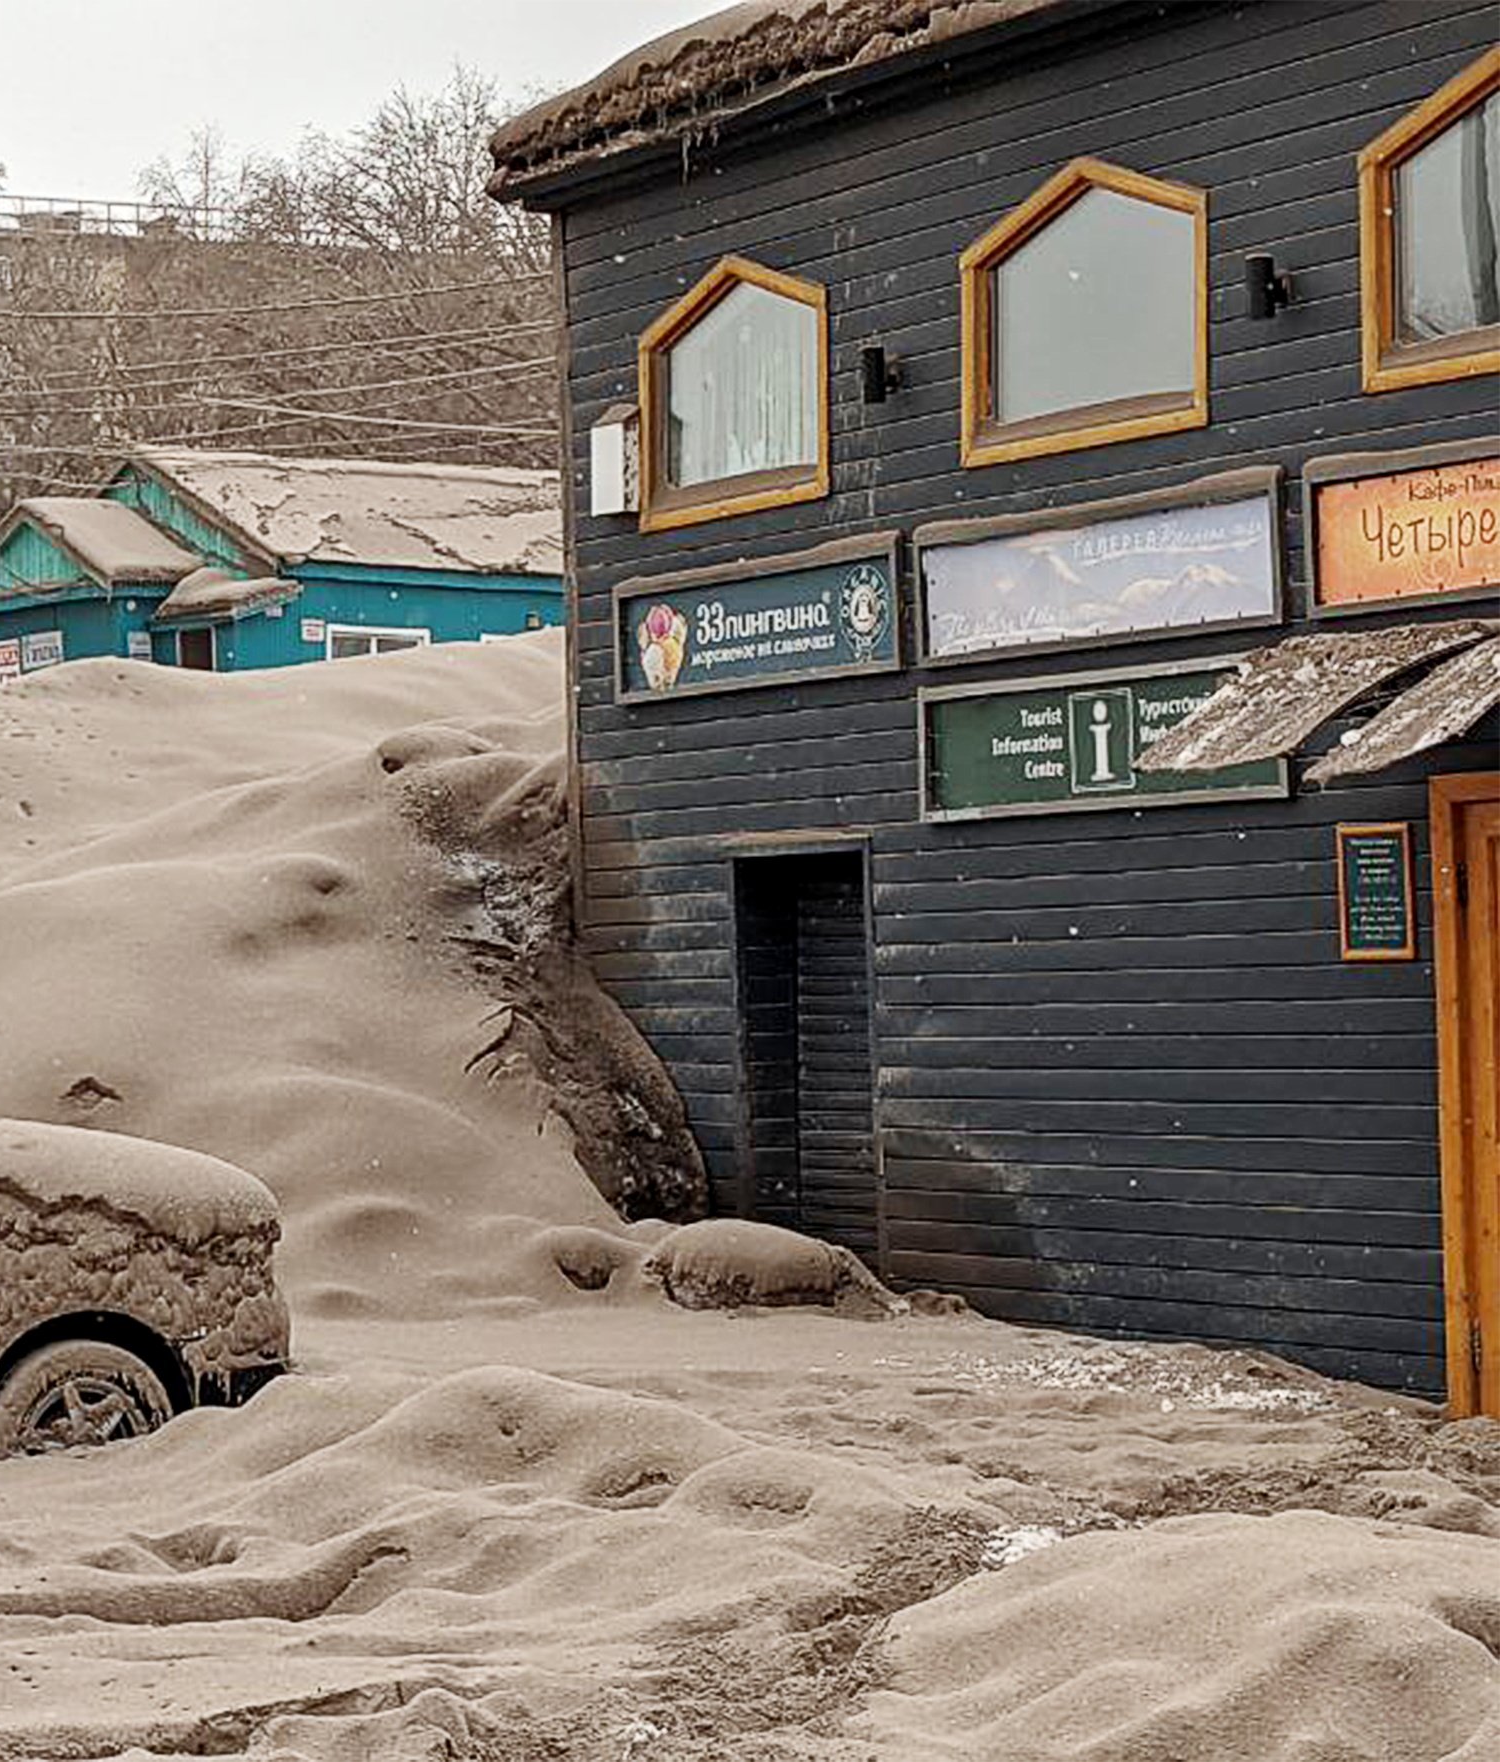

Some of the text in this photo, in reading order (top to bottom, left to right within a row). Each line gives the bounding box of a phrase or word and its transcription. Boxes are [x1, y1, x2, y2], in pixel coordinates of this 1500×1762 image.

[1362, 504, 1498, 569] Четыре
[1020, 707, 1063, 728] Tourist
[992, 734, 1063, 756] Information
[1024, 760, 1065, 779] Centre
